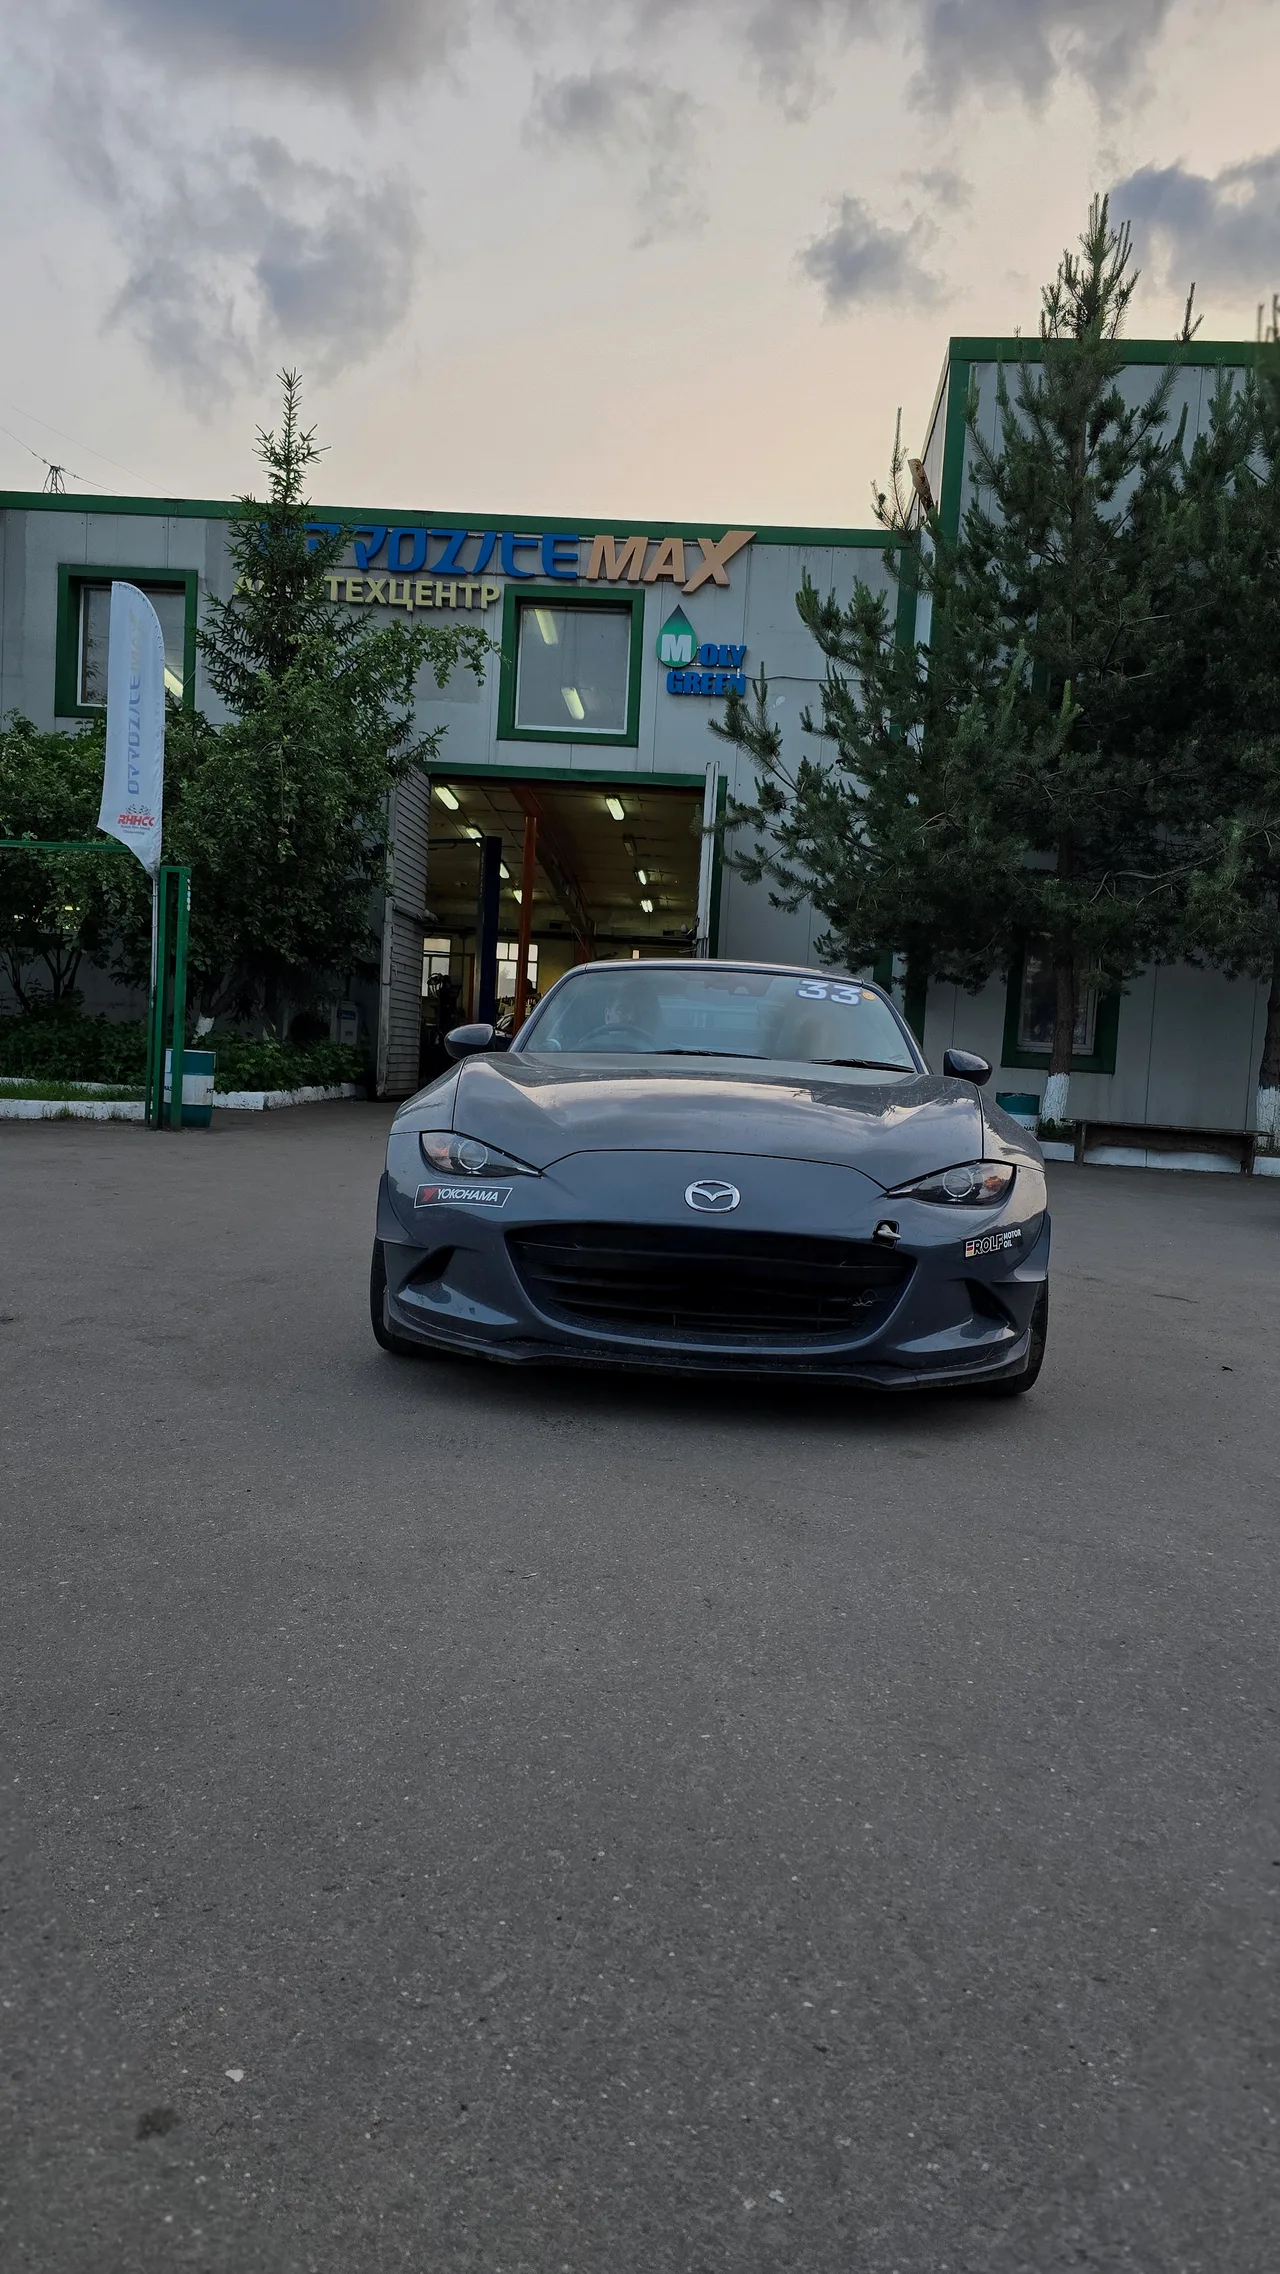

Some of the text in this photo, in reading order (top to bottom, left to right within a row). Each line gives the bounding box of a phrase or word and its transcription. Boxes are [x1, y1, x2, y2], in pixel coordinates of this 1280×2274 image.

[586, 530, 757, 593] MAX
[666, 671, 747, 697] GREEN
[796, 980, 863, 1006] 33
[437, 1188, 499, 1202] YOKOHAMA
[973, 1229, 1022, 1256] ROLF MOTOR
[1003, 1240, 1013, 1248] OIL
